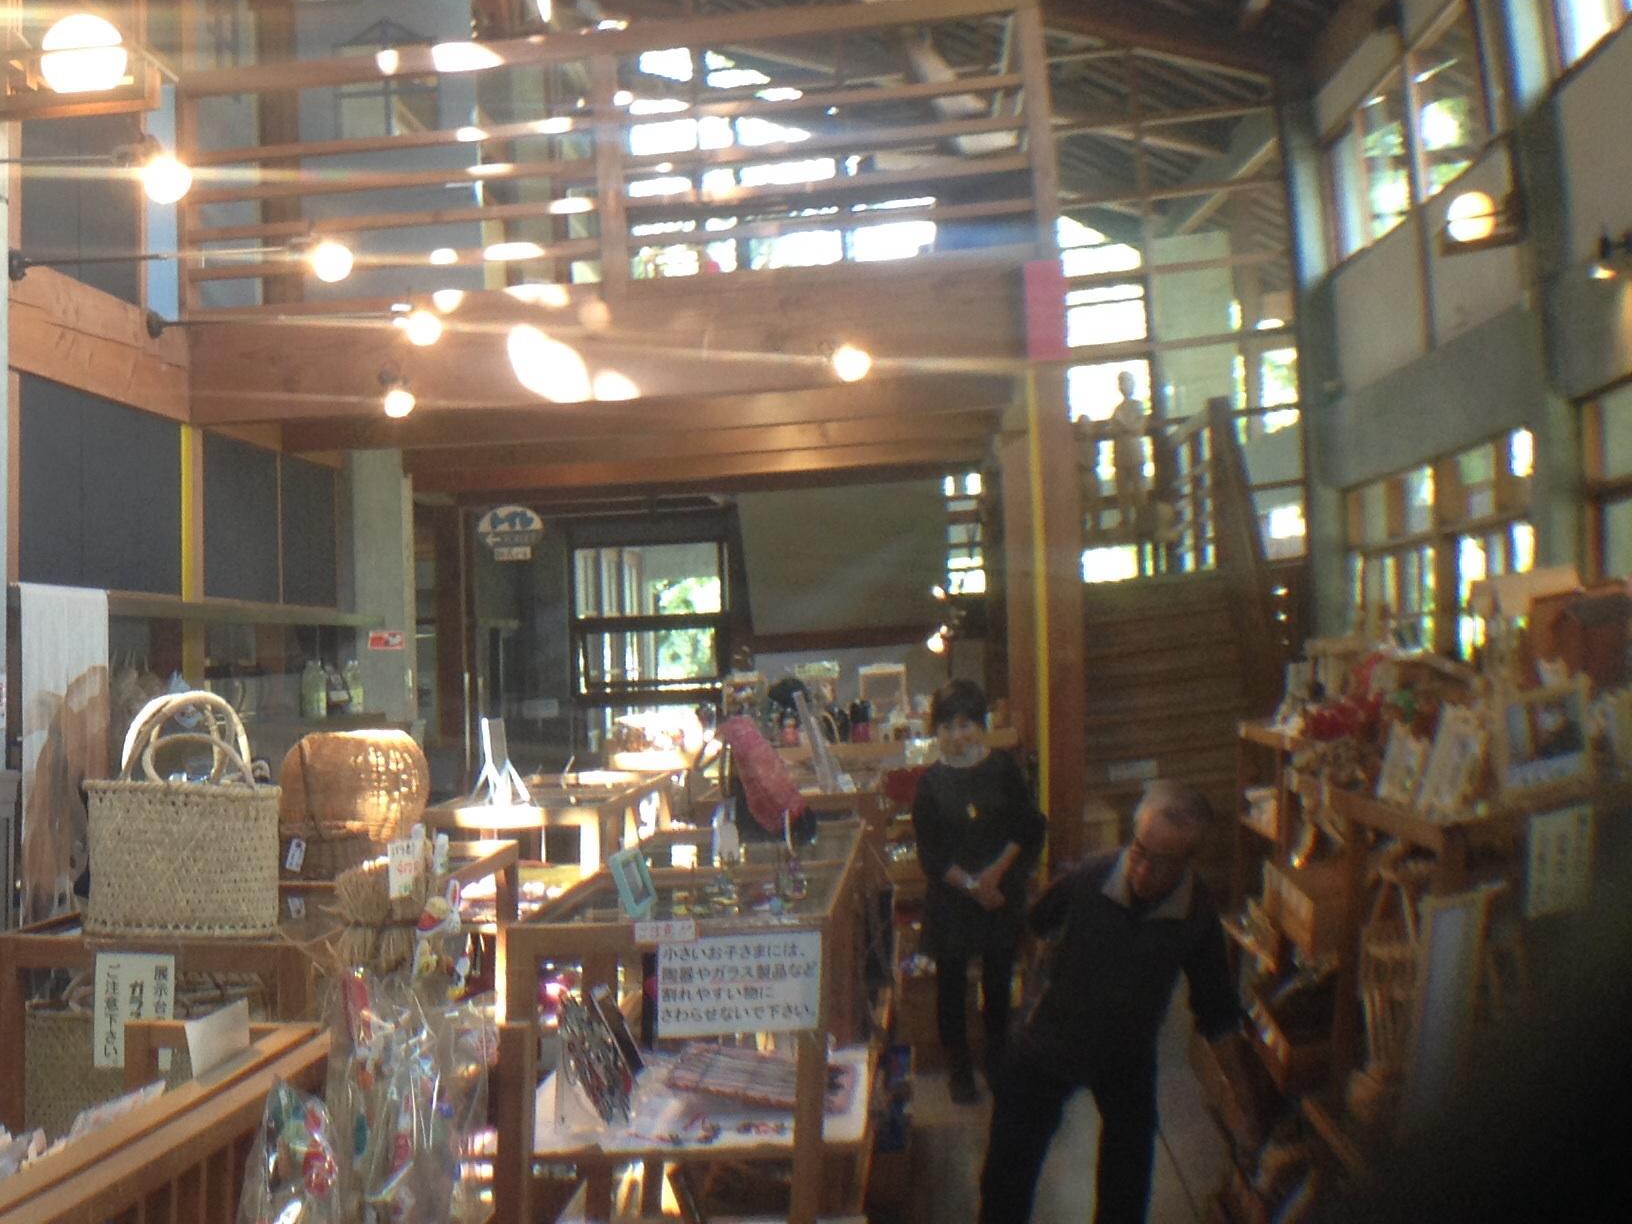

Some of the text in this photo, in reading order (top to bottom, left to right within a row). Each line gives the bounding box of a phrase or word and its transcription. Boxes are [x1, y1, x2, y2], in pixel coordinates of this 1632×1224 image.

[490, 510, 534, 530] トイレ
[153, 965, 169, 1020] 展示台
